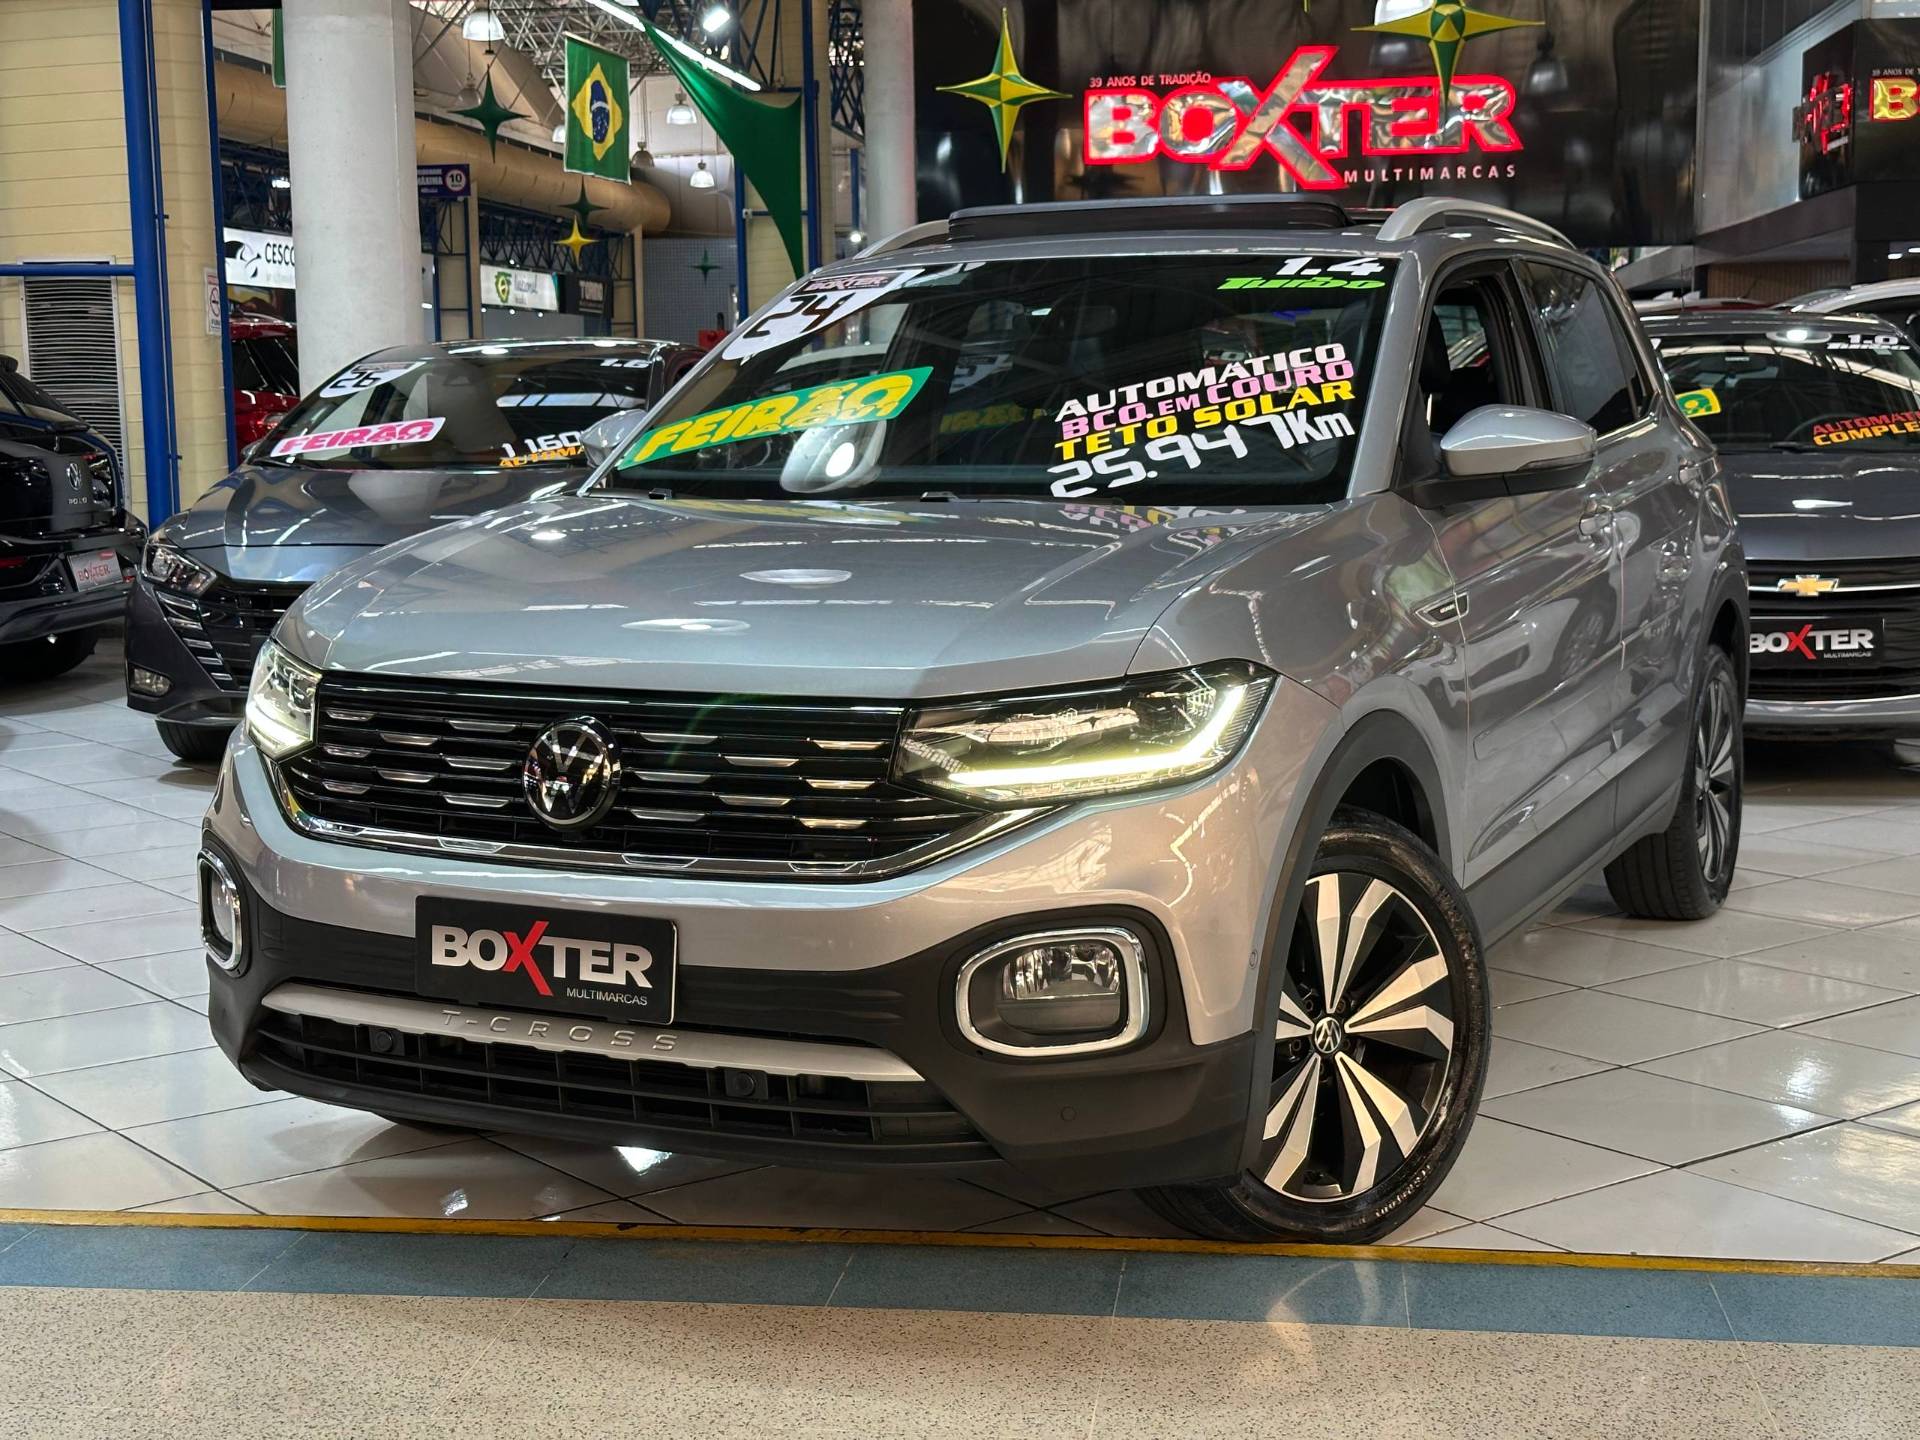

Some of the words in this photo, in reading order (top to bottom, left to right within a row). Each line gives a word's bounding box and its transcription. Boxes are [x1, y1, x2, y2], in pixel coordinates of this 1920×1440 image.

[1089, 77, 1103, 88] 39
[1106, 76, 1136, 87] ANOS
[1141, 75, 1155, 86] DE
[1159, 71, 1211, 85] TRADIÇÃO
[1083, 45, 1525, 190] BOXTER
[449, 173, 463, 183] 10
[1343, 164, 1516, 183] MULTIMARCAS
[1276, 256, 1385, 276] 1.4
[1216, 276, 1386, 290] Turbo
[742, 292, 857, 339] 24
[1847, 334, 1899, 345] 1.0
[328, 371, 382, 389] 26
[1055, 343, 1346, 422] AUTOMÁTICO
[1062, 402, 1153, 440] BCO.
[1158, 393, 1200, 415] EM
[1207, 360, 1354, 405] COURO
[1054, 415, 1178, 461] TETO
[1193, 380, 1355, 429] SOLAR
[1813, 421, 1920, 446] COMPLE
[68, 497, 88, 505] POLO
[1749, 624, 1874, 660] BOXTER
[1823, 650, 1872, 659] MULTIMARCAS
[431, 920, 653, 997] BOXTER
[566, 986, 648, 1006] MULTIMARCAS
[441, 1009, 679, 1051] T-CROSS
